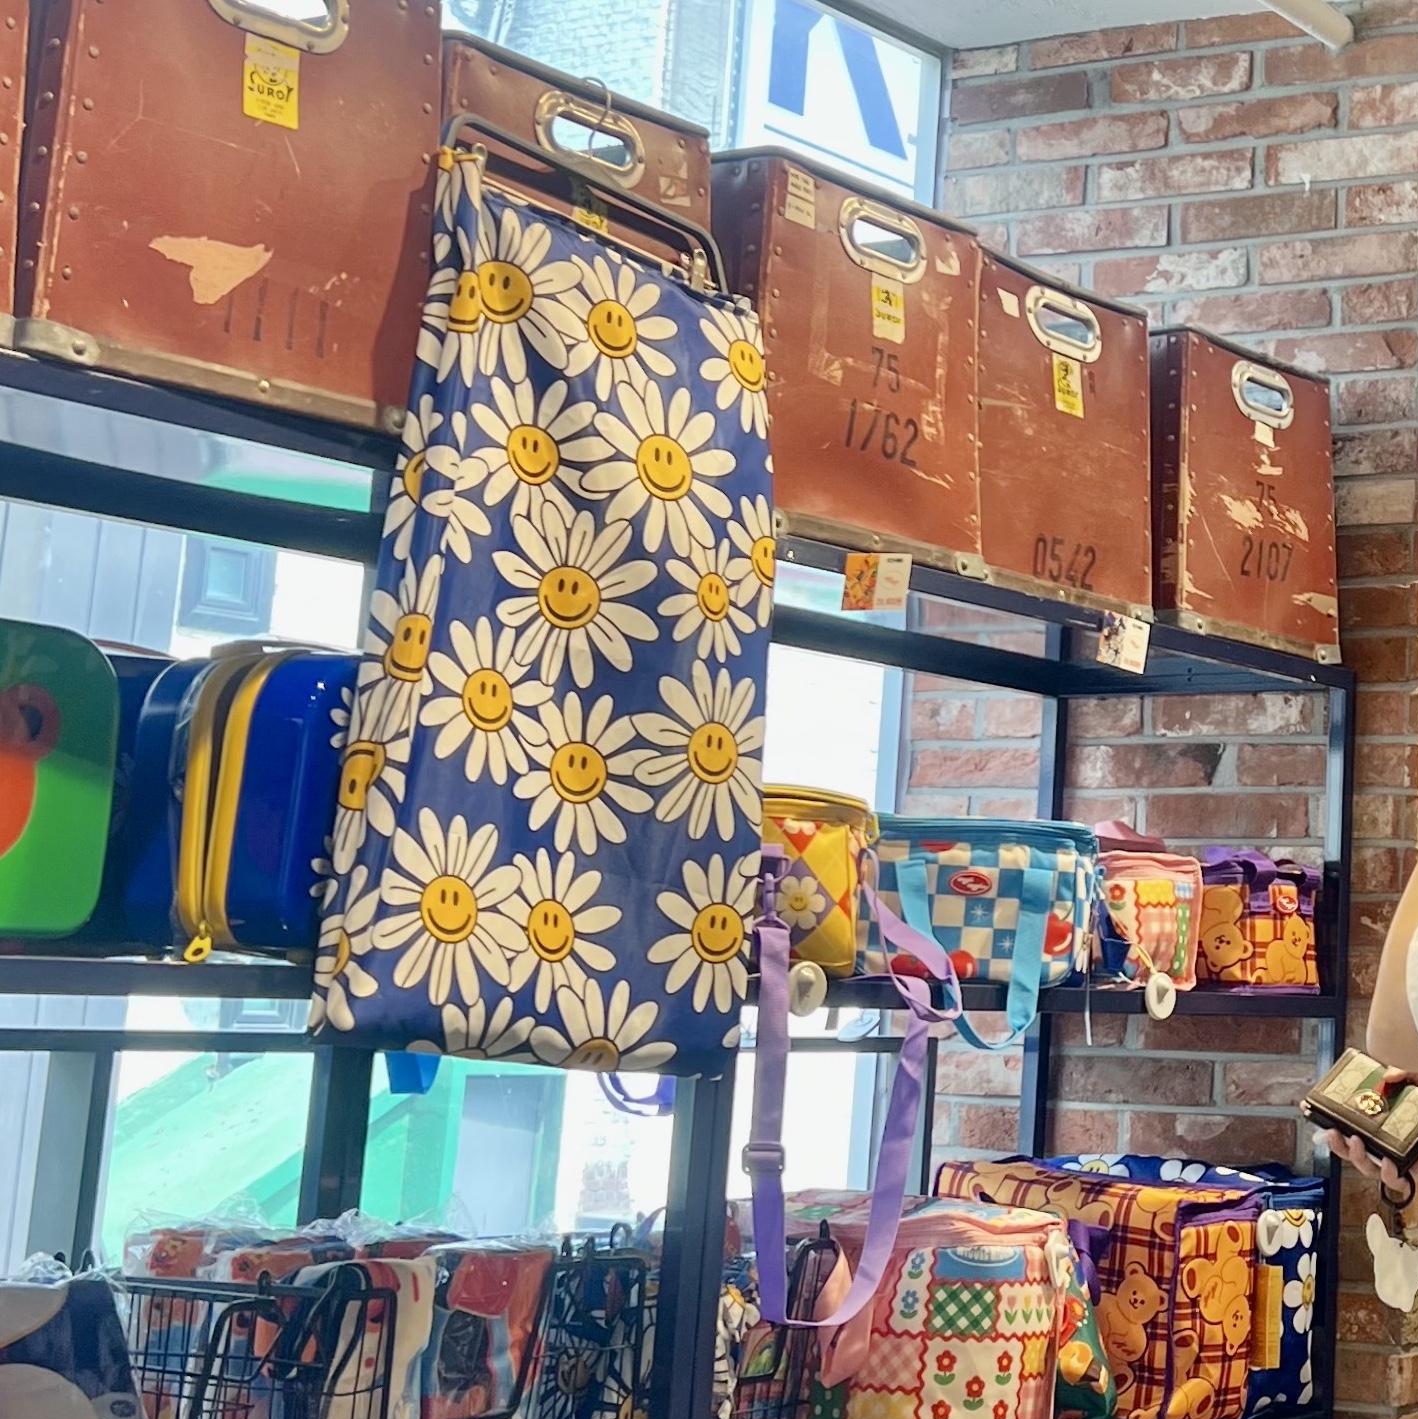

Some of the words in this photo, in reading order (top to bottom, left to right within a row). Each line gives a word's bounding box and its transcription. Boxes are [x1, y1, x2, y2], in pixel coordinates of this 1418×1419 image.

[871, 345, 900, 394] 75
[844, 398, 919, 469] 1762
[1256, 480, 1277, 517] 75
[1032, 532, 1096, 592] 0542
[1240, 534, 1294, 582] 2107
